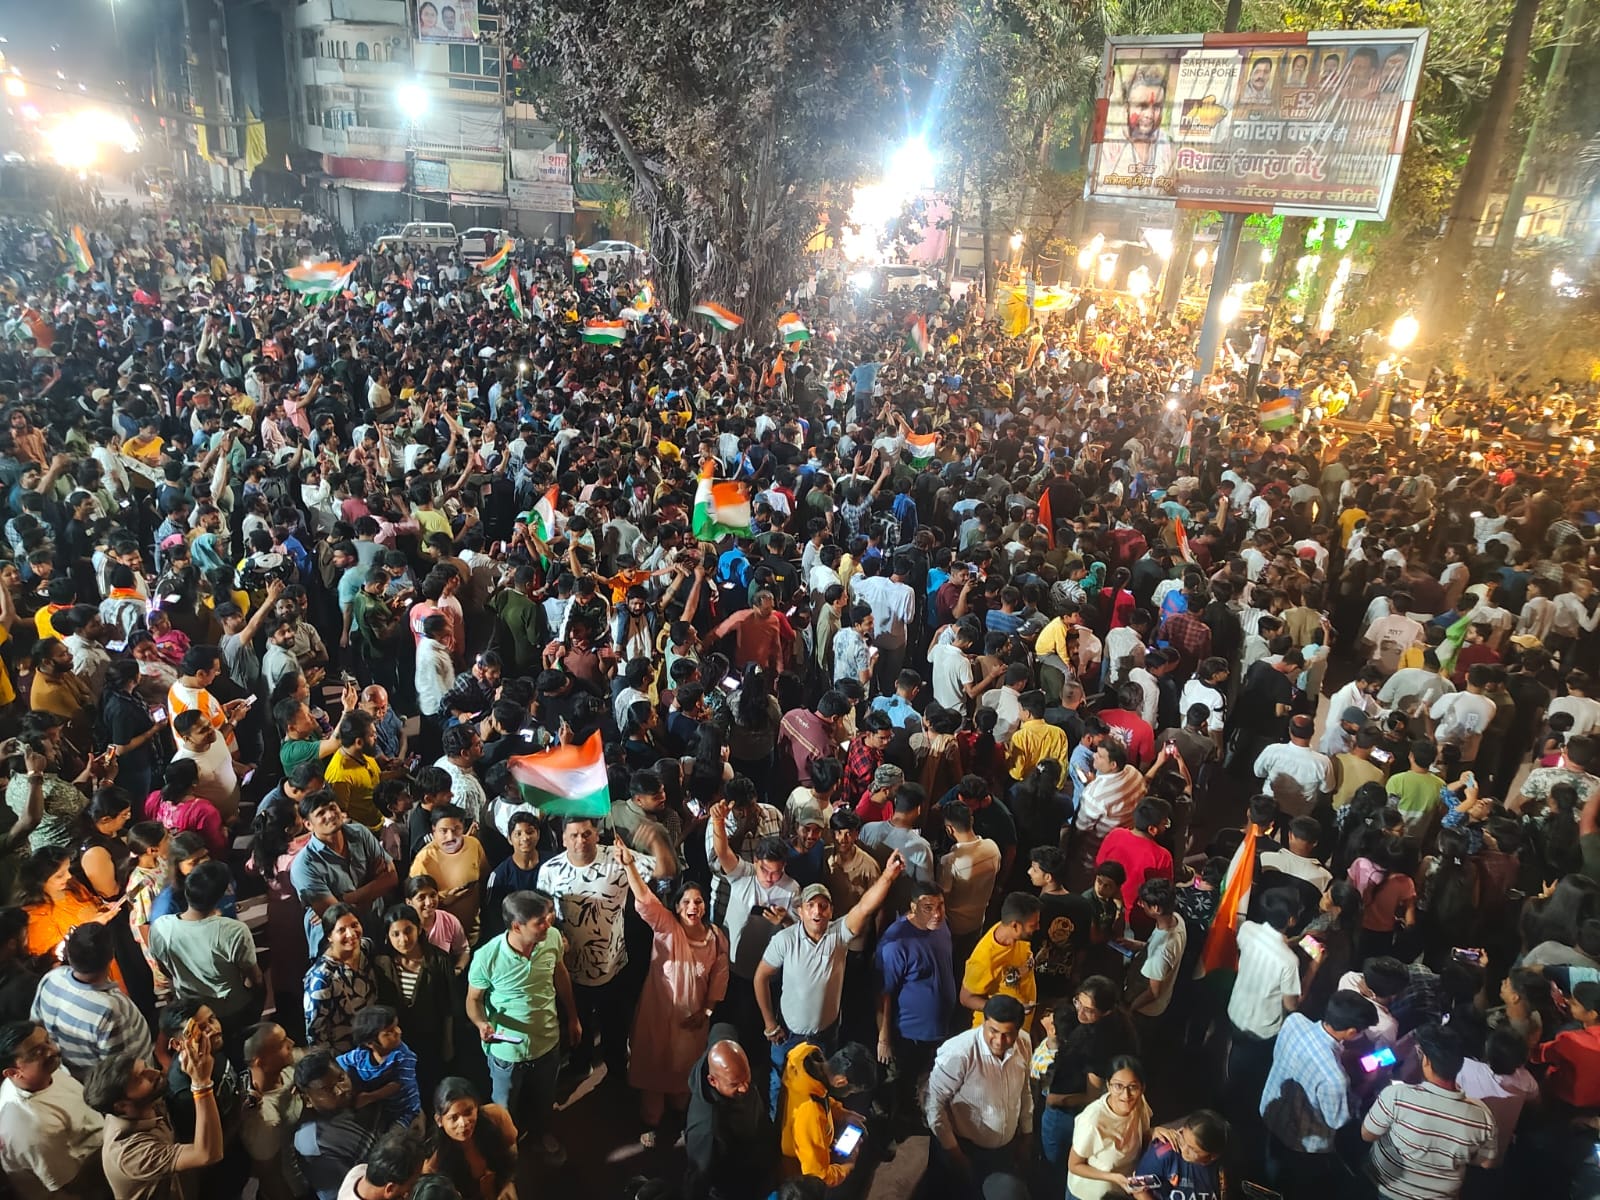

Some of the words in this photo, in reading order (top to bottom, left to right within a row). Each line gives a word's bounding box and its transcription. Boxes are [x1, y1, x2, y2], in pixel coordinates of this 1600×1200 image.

[1183, 58, 1229, 67] SARTHAK
[1181, 68, 1238, 77] SINGAPORE
[1298, 92, 1316, 109] 52
[1177, 148, 1230, 173] विशाल
[1234, 185, 1278, 198] मॉरल
